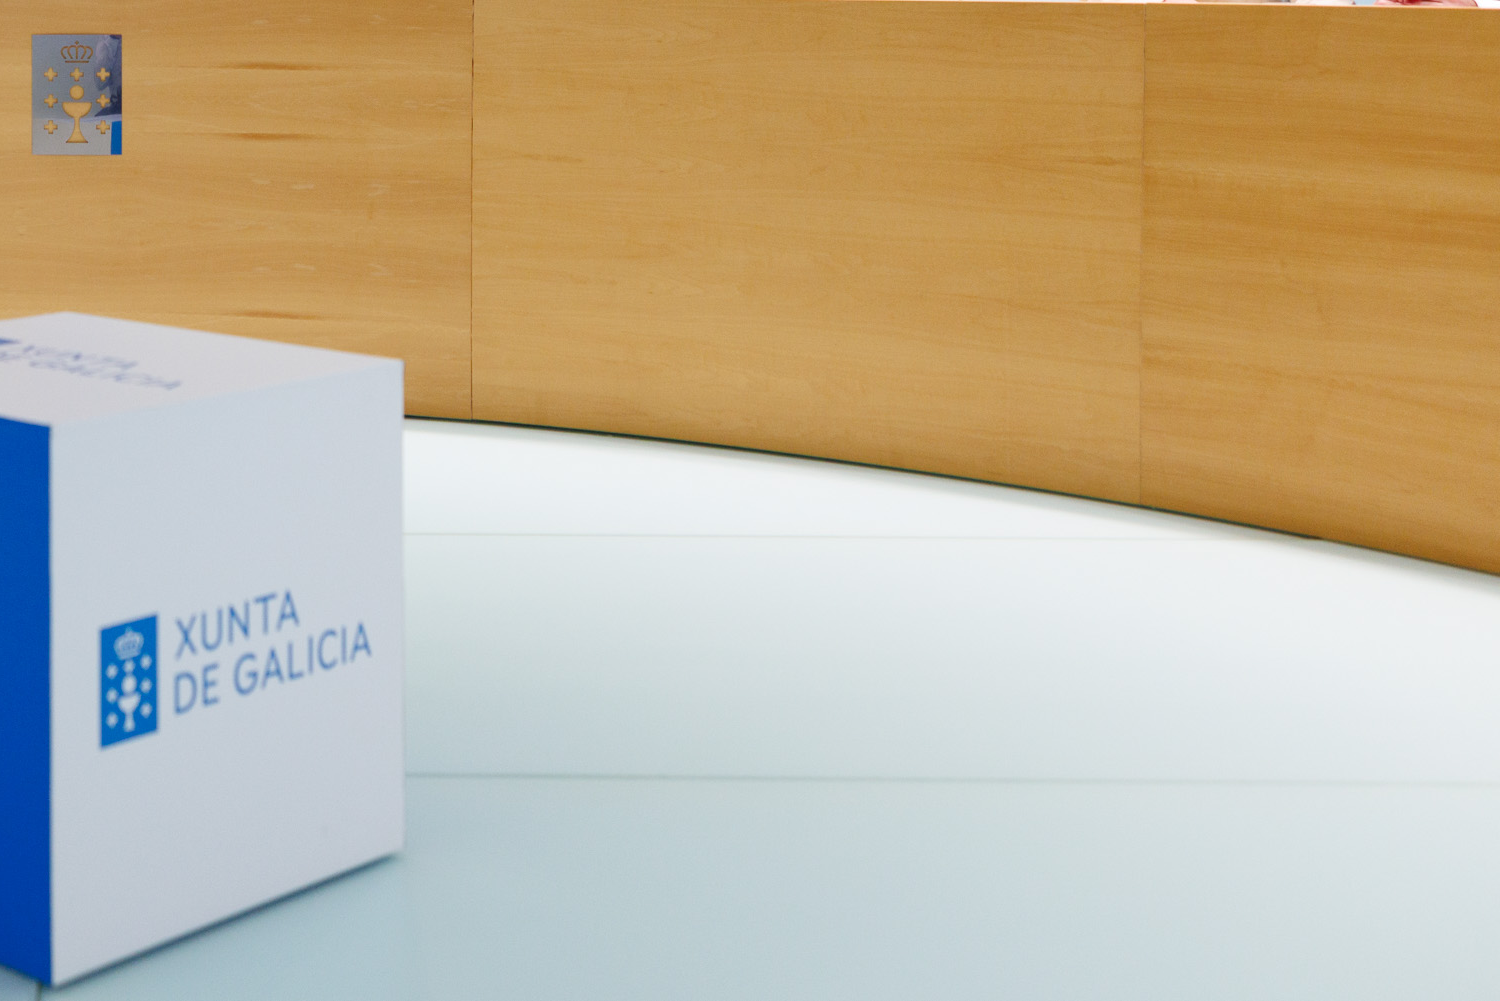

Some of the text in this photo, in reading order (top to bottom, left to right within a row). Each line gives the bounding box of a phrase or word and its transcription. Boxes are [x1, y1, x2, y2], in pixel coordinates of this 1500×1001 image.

[174, 588, 300, 662] XUNTA
[173, 620, 373, 716] DE GALICIA
